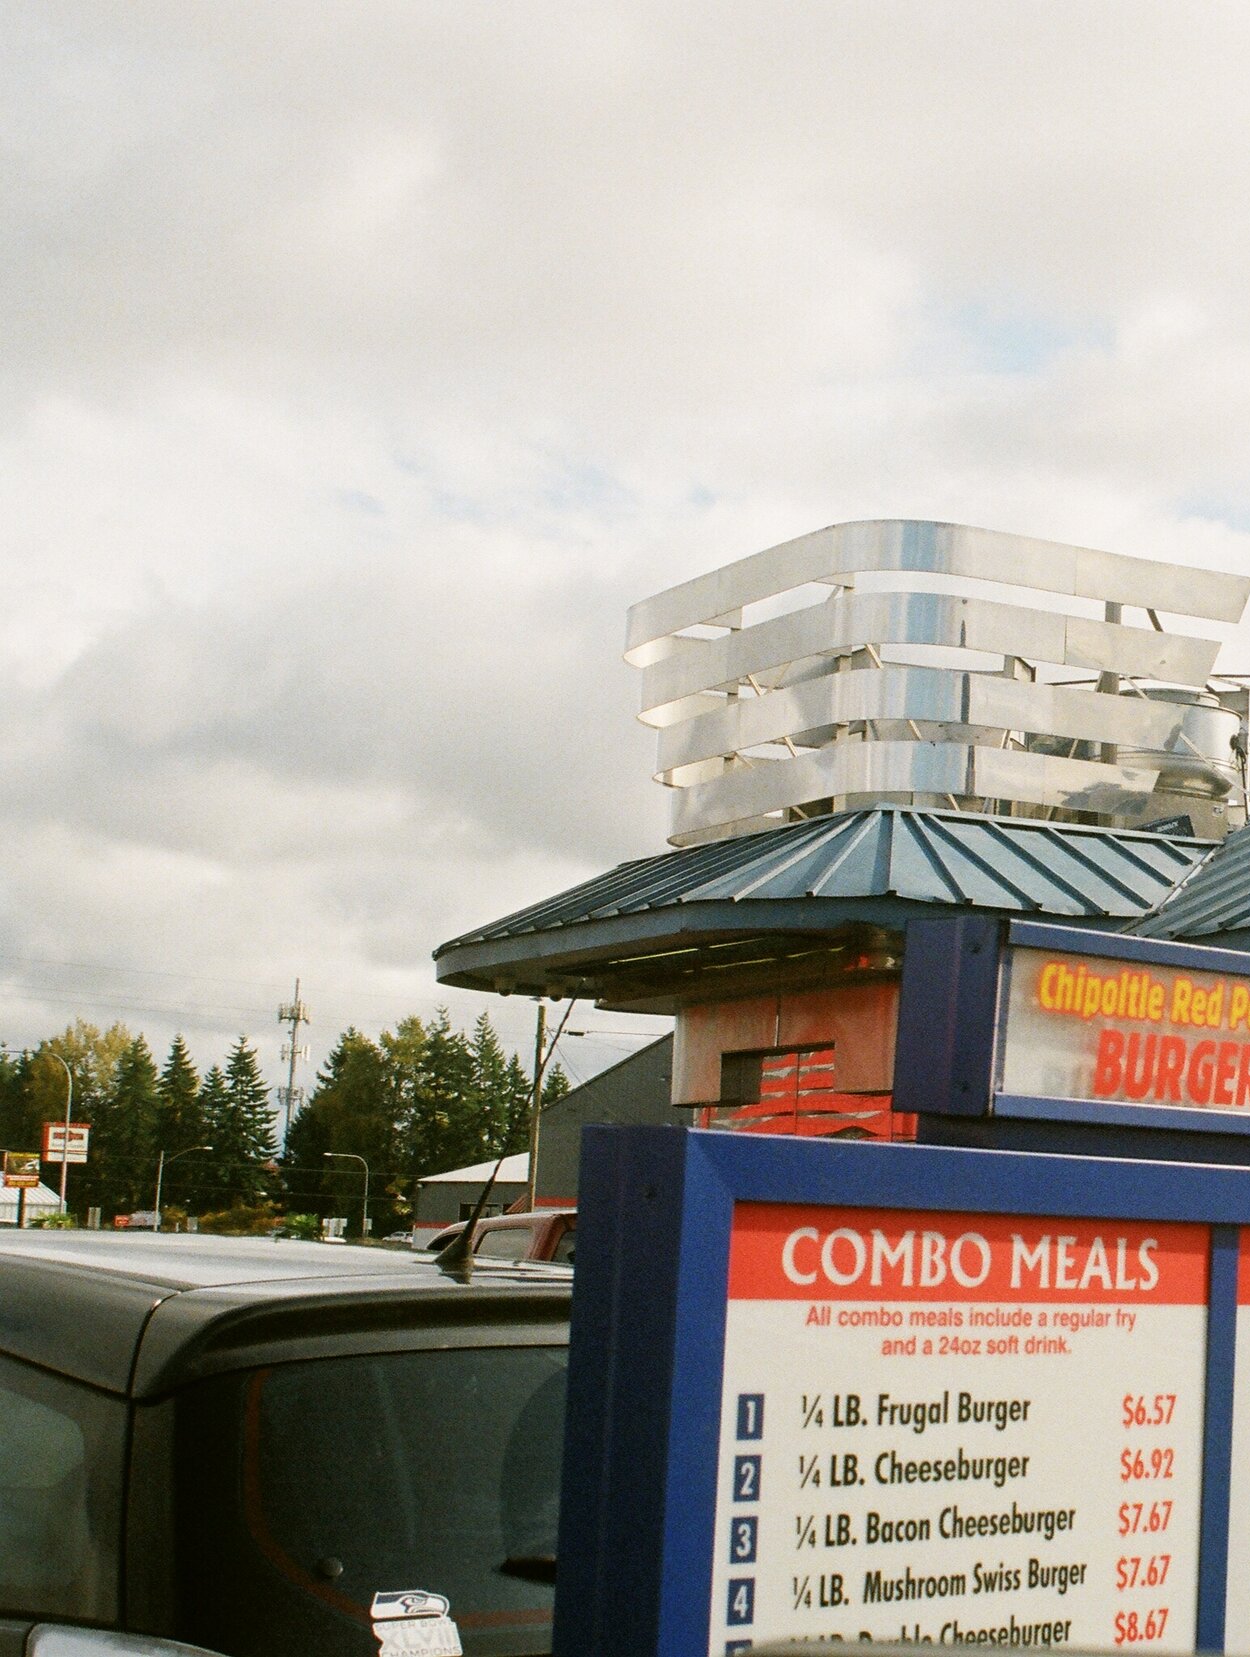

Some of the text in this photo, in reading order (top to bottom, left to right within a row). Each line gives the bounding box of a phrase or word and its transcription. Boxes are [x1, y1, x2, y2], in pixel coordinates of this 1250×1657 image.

[1169, 975, 1223, 1028] Red
[781, 1227, 1159, 1290] COMBO MEALS
[806, 1306, 1136, 1332] All combo meals include a regular fry
[882, 1335, 1072, 1355] and a 24oz soft drink.
[744, 1399, 756, 1433] 1
[833, 1394, 867, 1427] LB.
[877, 1390, 949, 1435] Frugal
[958, 1392, 1031, 1431] Burger
[1122, 1394, 1176, 1429] $6.57
[740, 1461, 754, 1496] 2
[830, 1453, 865, 1487] LB.
[875, 1447, 1030, 1488] Cheeseburger
[1120, 1447, 1174, 1483] $6.92
[736, 1522, 750, 1557] 3
[825, 1500, 1173, 1546] LB. Bacon Cheeseburger $7.67
[819, 1554, 1170, 1607] LB. Mushroom Swiss Burger $7.67
[733, 1583, 749, 1618] 4
[1114, 1609, 1168, 1645] $8.67
